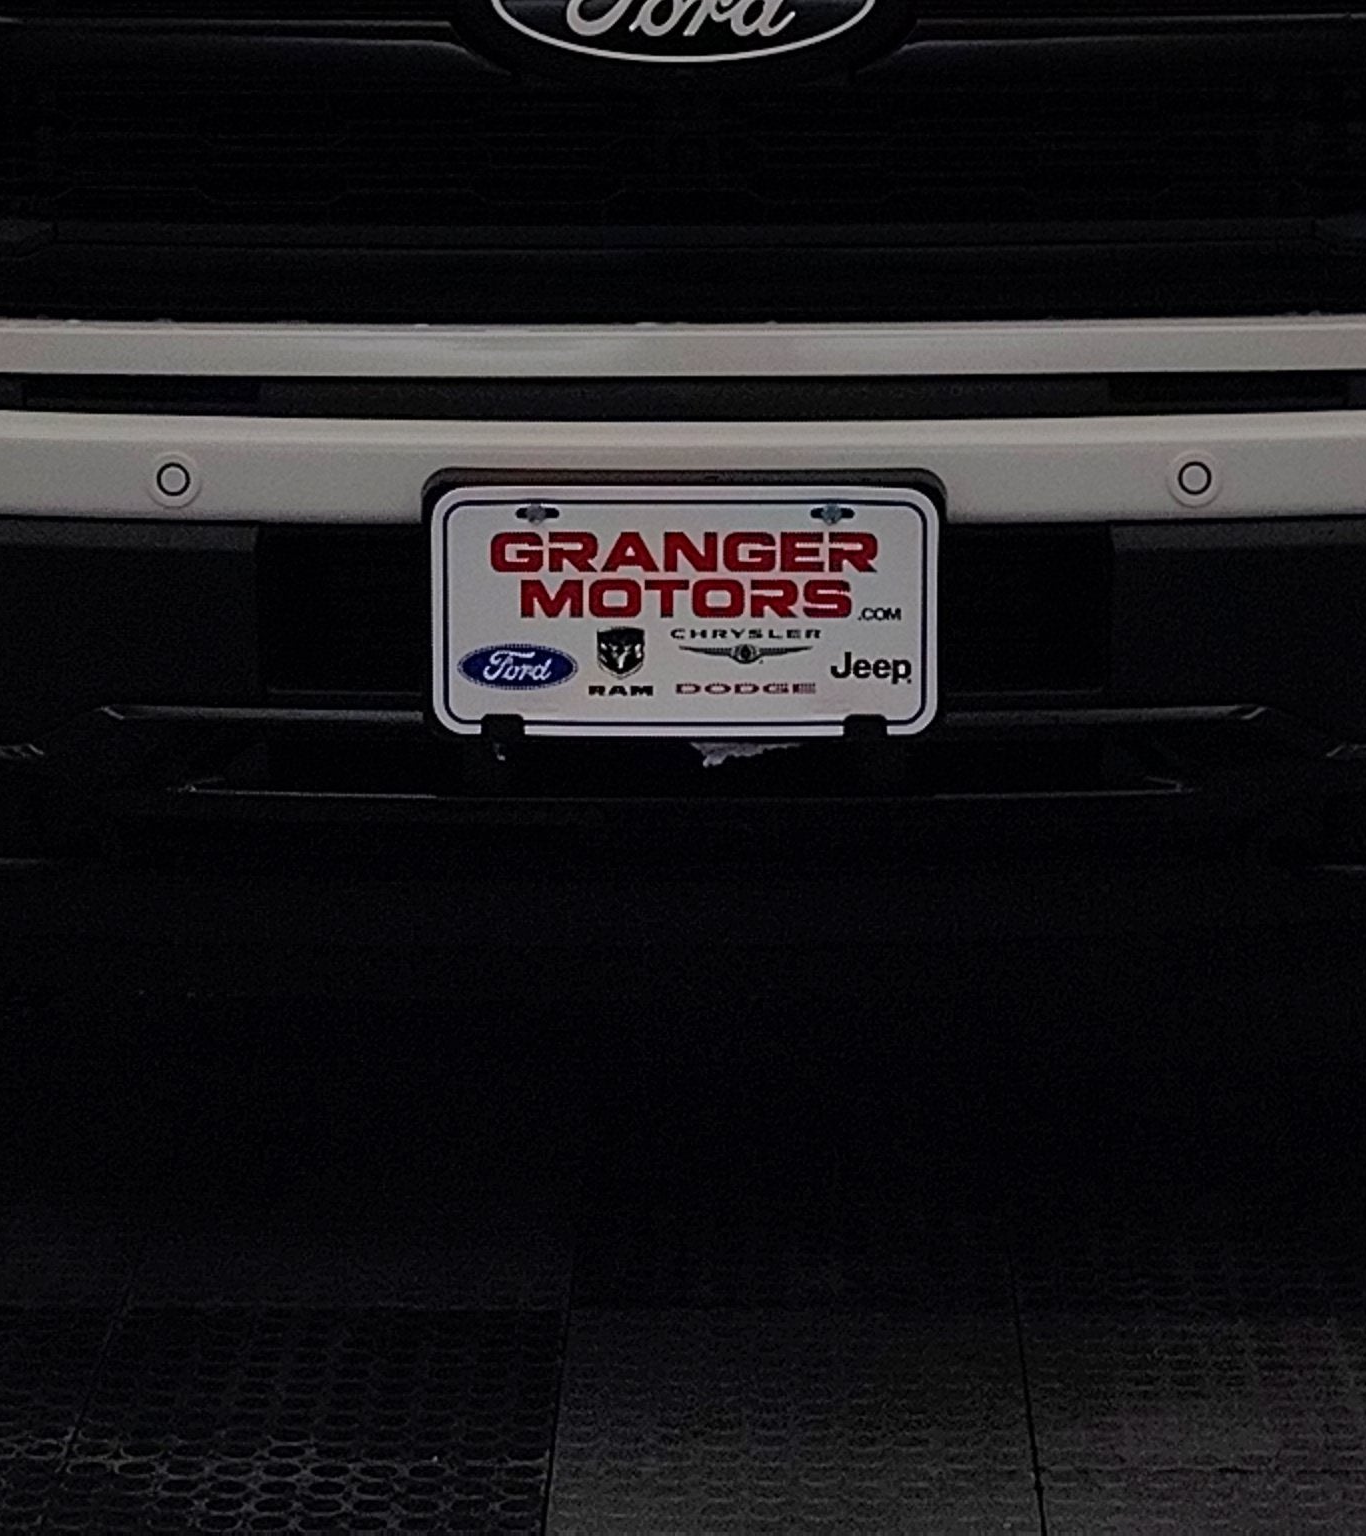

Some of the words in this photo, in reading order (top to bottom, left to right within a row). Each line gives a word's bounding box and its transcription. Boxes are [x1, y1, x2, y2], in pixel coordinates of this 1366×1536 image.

[490, 531, 879, 574] GRANGER
[520, 578, 853, 620] MOTORS
[857, 606, 903, 622] .COM
[670, 627, 822, 640] CHRYSLER
[482, 650, 553, 683] Ford
[830, 652, 912, 685] Jeep
[588, 684, 654, 697] RAM
[675, 682, 817, 696] DODGE
